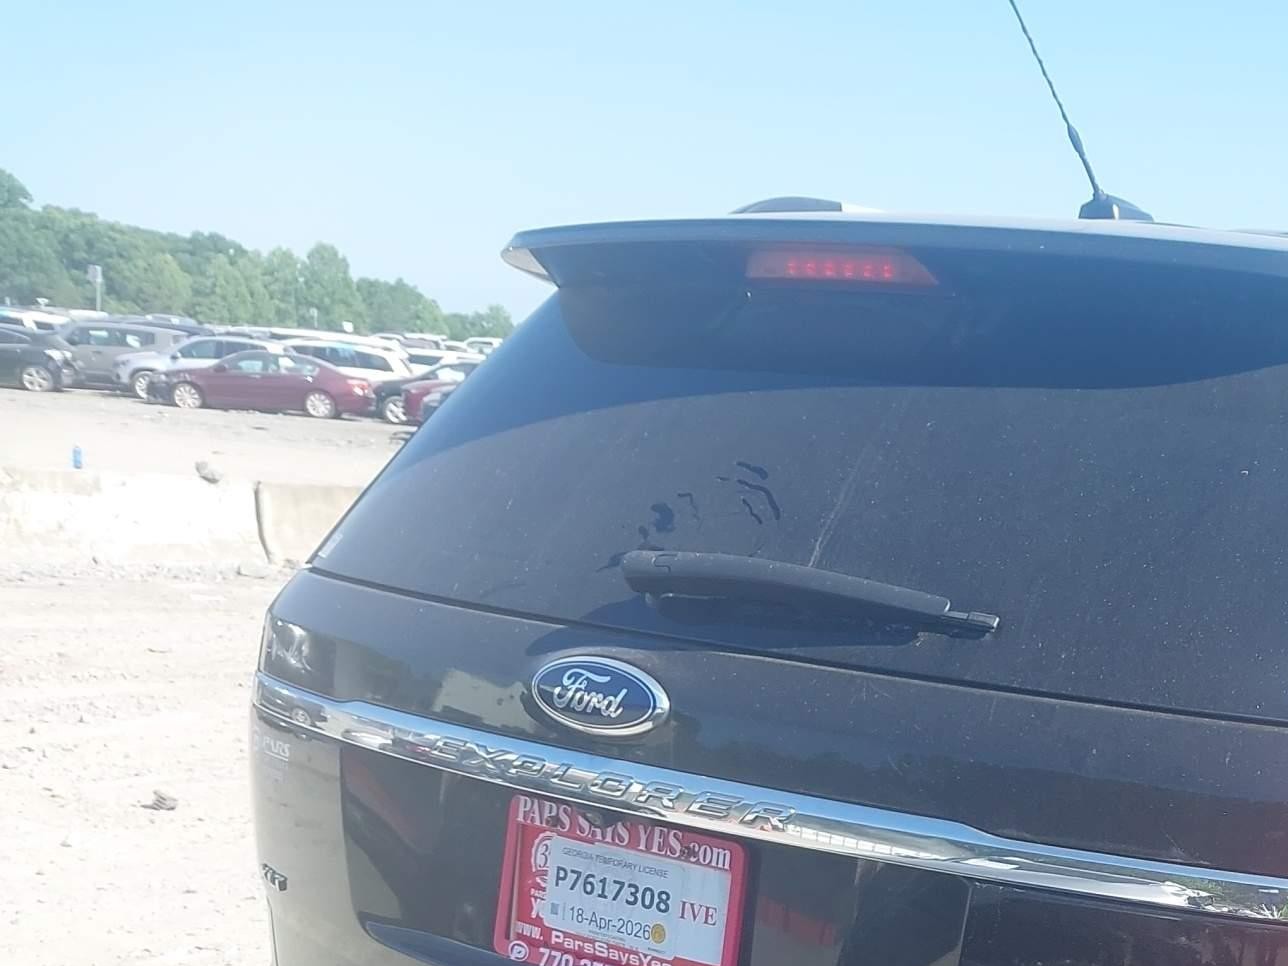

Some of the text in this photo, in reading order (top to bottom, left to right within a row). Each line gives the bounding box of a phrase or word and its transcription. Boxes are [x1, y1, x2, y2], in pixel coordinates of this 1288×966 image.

[553, 668, 628, 718] Ford
[431, 736, 796, 832] EXPLORER
[517, 795, 571, 834] PARS
[562, 846, 669, 879] GEORGIA TEMPORARY LICENSE
[555, 866, 671, 914] P7617308
[569, 906, 651, 940] 18-Apr-2026
